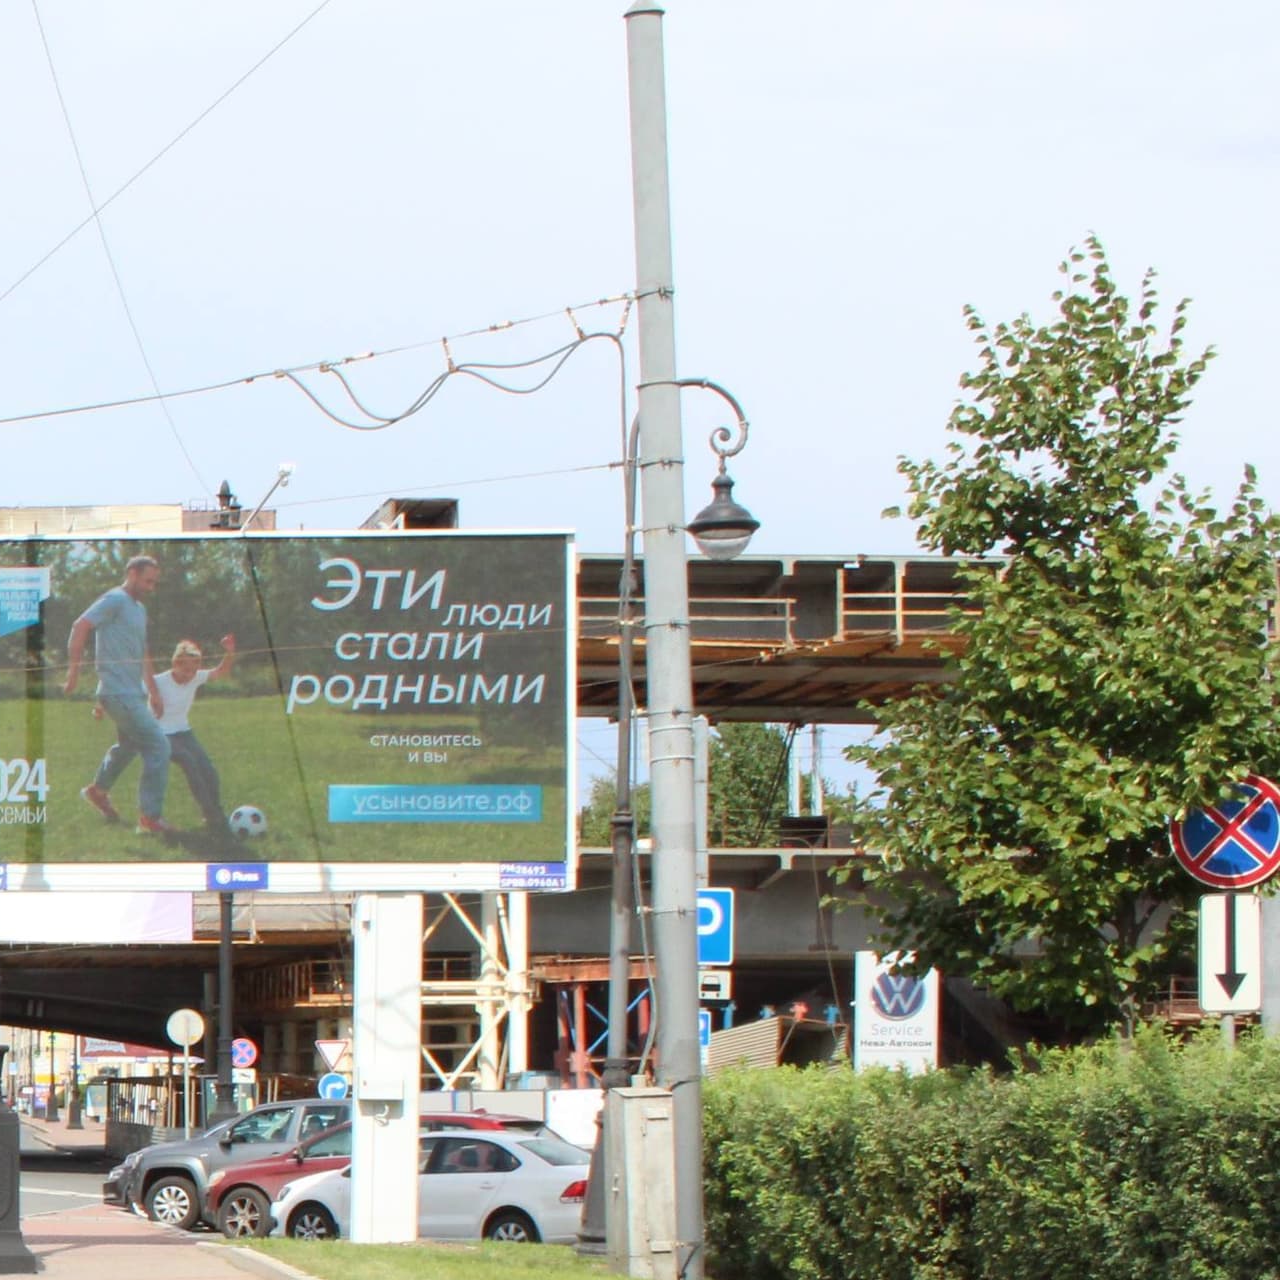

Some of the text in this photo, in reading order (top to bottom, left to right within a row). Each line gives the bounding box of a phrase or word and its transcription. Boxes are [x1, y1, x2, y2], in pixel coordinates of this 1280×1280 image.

[311, 557, 553, 630] Эти люди
[335, 632, 484, 660] стали
[285, 674, 545, 714] родными
[369, 735, 482, 747] СТАНОВИТЕСЬ
[408, 752, 447, 763] И ВЫ
[353, 790, 533, 815] усыновите.рф
[871, 1023, 923, 1036] Service
